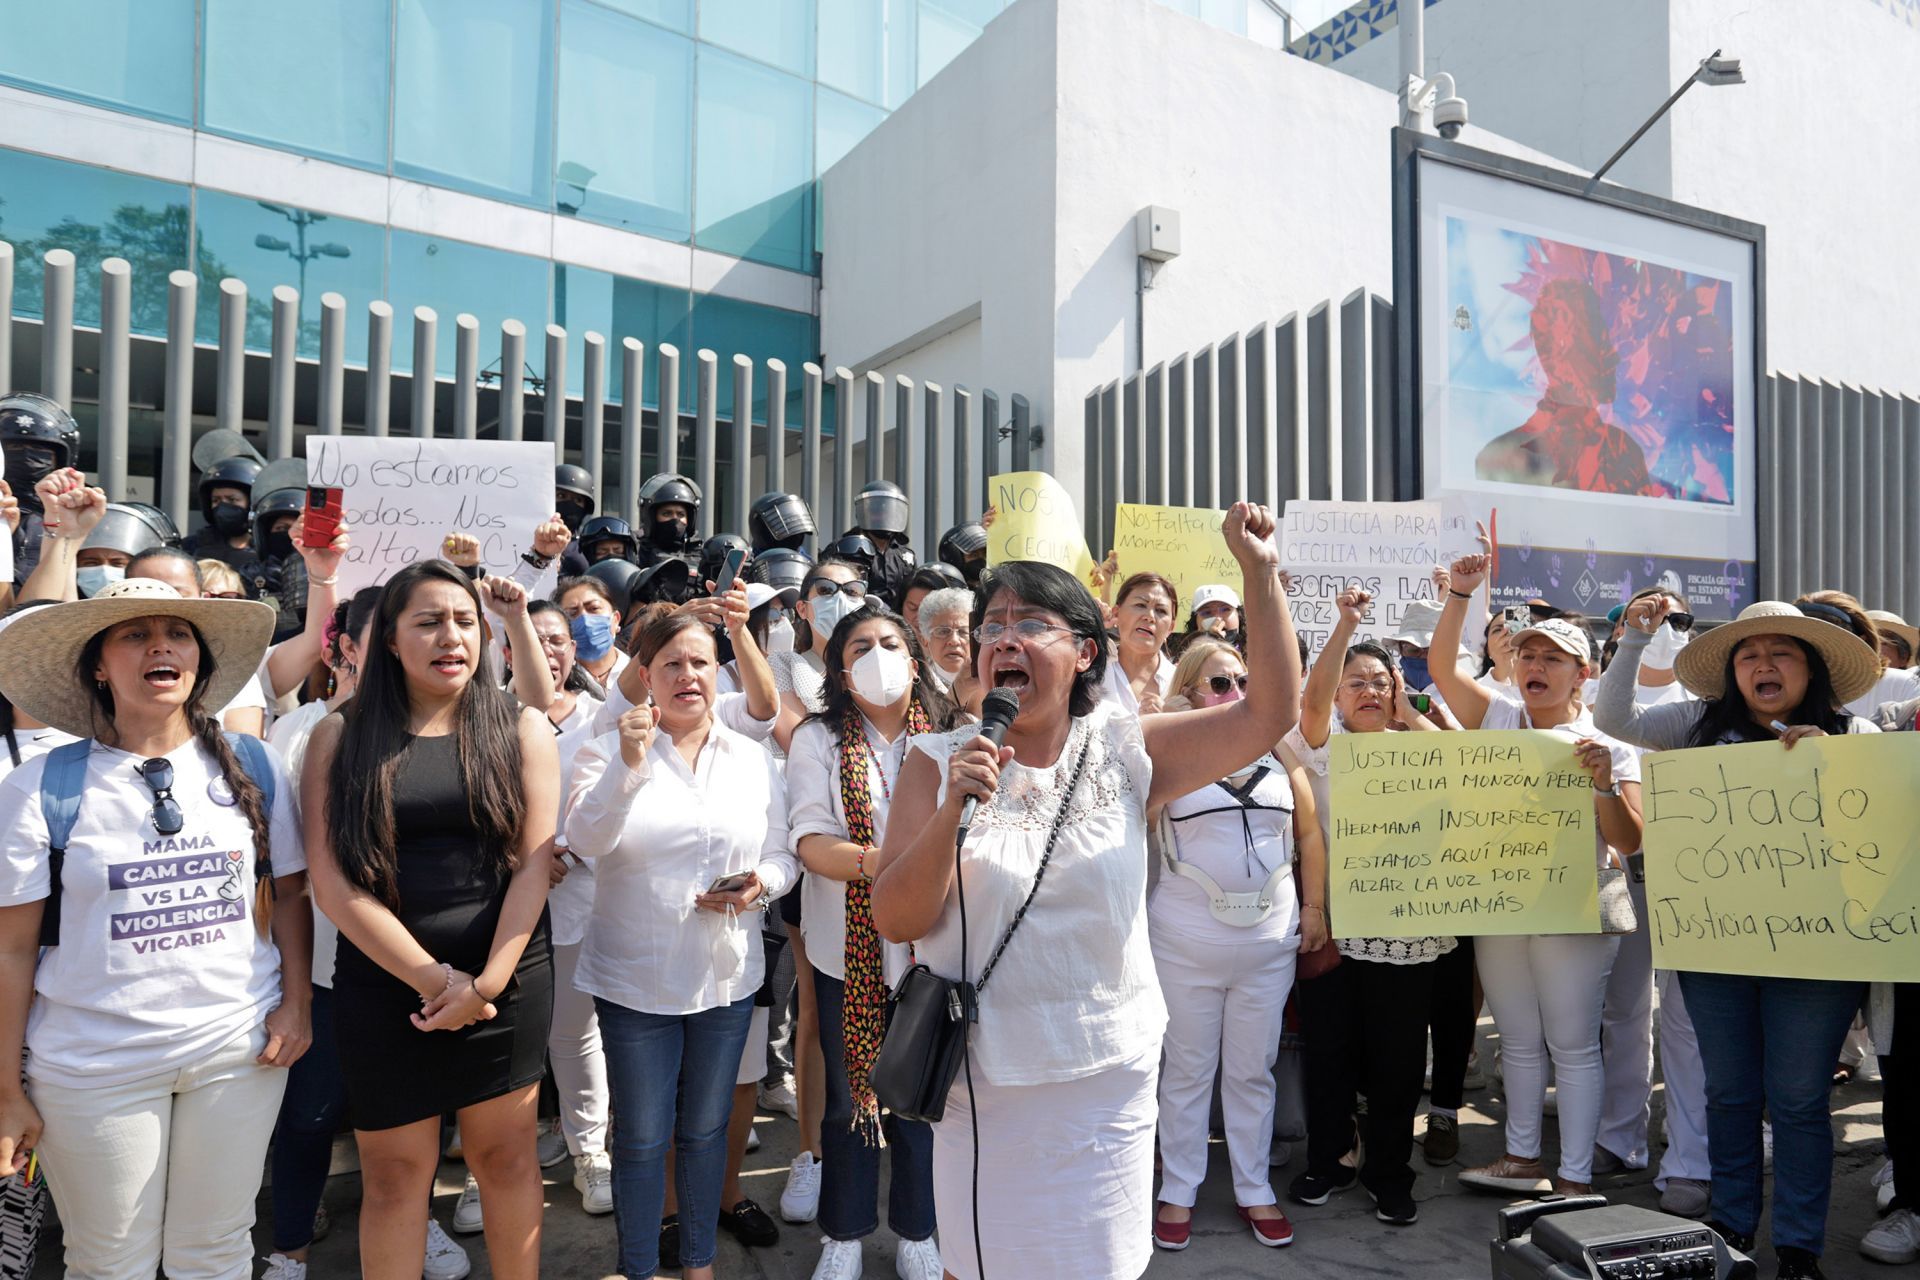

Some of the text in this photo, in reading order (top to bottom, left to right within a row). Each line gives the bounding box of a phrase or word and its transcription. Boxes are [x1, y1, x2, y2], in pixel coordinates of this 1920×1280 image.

[311, 441, 518, 488] No estamos
[344, 495, 506, 529] odas... Nos
[1119, 507, 1151, 530] Nos
[1152, 511, 1204, 534] Falta
[1288, 511, 1438, 537] JUSTICIA PARA
[344, 531, 419, 565] alta
[1119, 535, 1189, 552] Monzón
[1287, 542, 1358, 563] CECILIA
[1369, 542, 1437, 565] MONZÓN
[1399, 577, 1434, 600] LA
[1503, 586, 1514, 596] de
[1340, 742, 1521, 773] JUSTICIA PARA
[1364, 776, 1447, 796] CECILIA
[1462, 768, 1540, 789] MONZÓN
[1648, 759, 1869, 827] Estado
[1336, 808, 1581, 839] HERMANA INSURRECTA
[143, 832, 215, 855] MAMÁ
[1343, 841, 1548, 870] ESTAMOS AQUÍ PARA
[123, 858, 222, 883] CAM CAI
[1675, 834, 1886, 889] cómplice
[1349, 878, 1404, 894] ALZAR
[1414, 878, 1438, 893] LA
[1446, 874, 1481, 888] VOZ
[1492, 867, 1531, 883] POR
[142, 885, 208, 906] VS LA
[1389, 891, 1525, 918] #NIUNAMÁS
[115, 904, 239, 933] VIOLENCIA
[1765, 914, 1836, 952] para
[1842, 899, 1920, 943] Ceci
[132, 928, 226, 955] VICARIA
